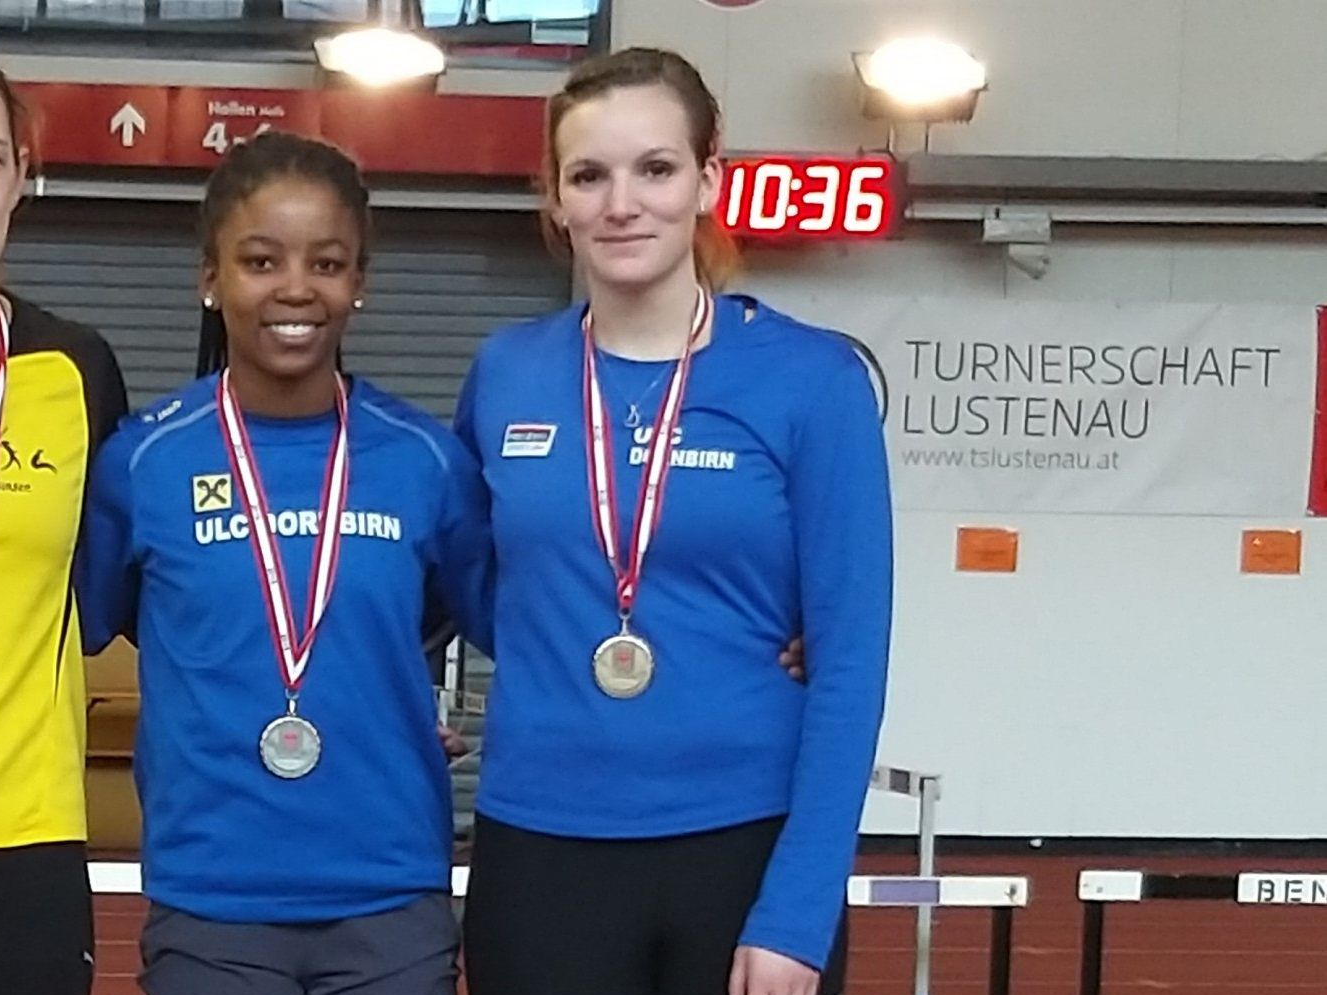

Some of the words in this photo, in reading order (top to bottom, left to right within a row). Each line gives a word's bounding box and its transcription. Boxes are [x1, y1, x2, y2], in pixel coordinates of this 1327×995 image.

[726, 163, 884, 232] 10:36
[905, 341, 1281, 388] TURNERSCHAFT
[903, 394, 1150, 439] LUSTENAU
[629, 446, 735, 469] DNBIRN
[902, 448, 1120, 470] www.tslustenau.at
[194, 514, 250, 545] ULC
